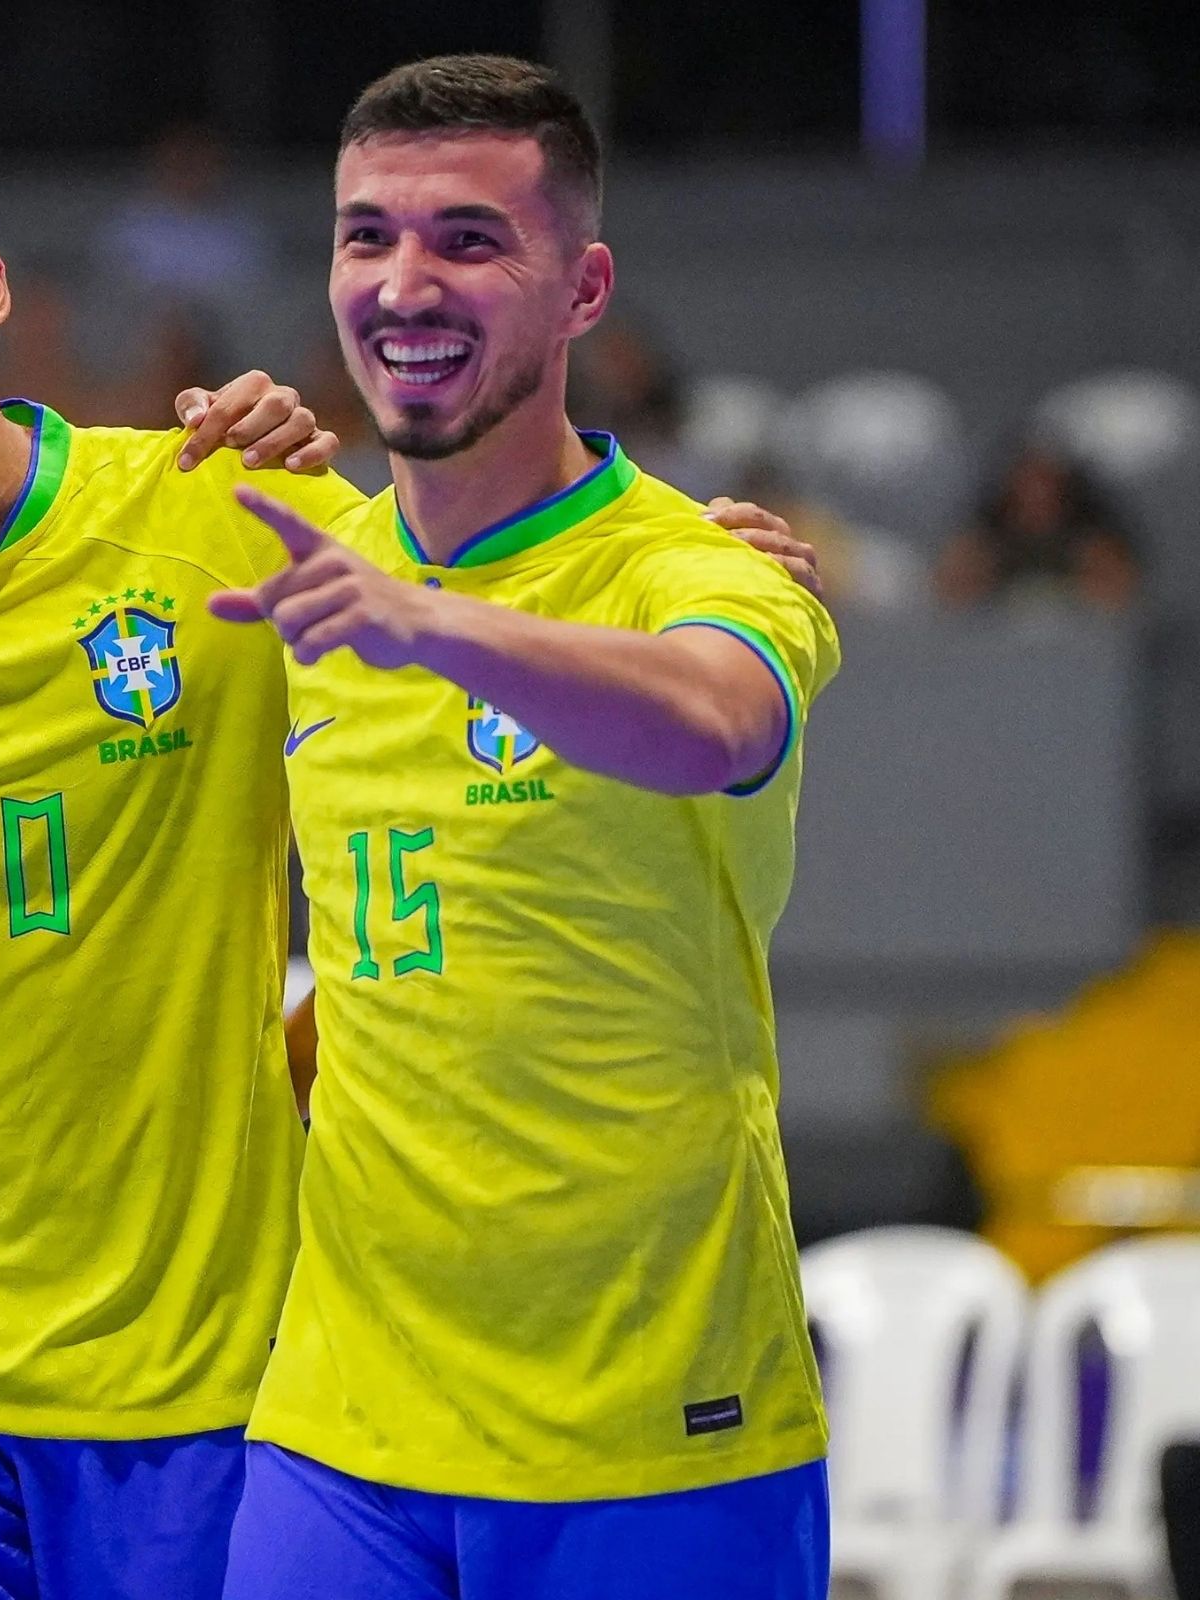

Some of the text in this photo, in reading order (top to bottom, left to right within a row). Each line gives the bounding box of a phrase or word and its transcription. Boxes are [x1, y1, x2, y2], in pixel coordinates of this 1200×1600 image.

[116, 655, 151, 673] CBF
[99, 727, 193, 765] BRASIL
[466, 779, 555, 805] BRASIL
[347, 826, 443, 981] 15
